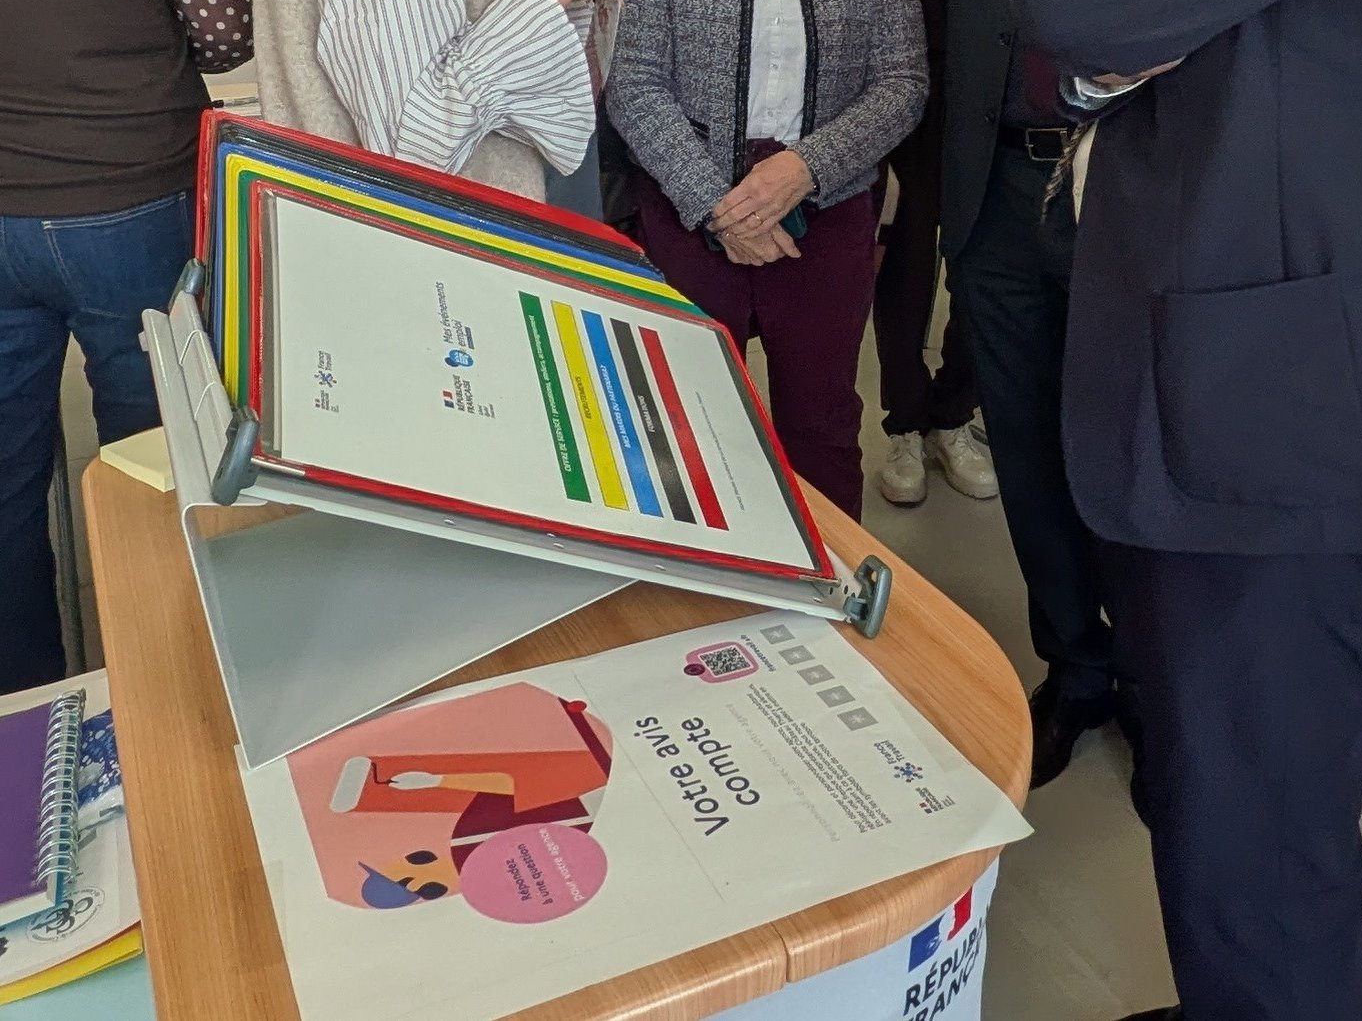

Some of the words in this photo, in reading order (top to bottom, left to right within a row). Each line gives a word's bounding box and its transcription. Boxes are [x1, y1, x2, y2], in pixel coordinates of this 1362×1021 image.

[435, 281, 451, 327] événements
[443, 327, 453, 344] Mes
[452, 318, 466, 347] emploi
[452, 374, 465, 412] RÉPUBLIQUE
[462, 380, 475, 414] FRANÇAISE
[599, 364, 617, 401] PARTENARIAT
[610, 402, 620, 410] DU
[638, 395, 656, 433] FORMATIONS
[551, 417, 565, 441] SERVICE
[556, 441, 567, 452] DE
[559, 451, 572, 472] OFFRE
[633, 716, 680, 758] avis
[874, 742, 897, 765] France
[681, 717, 760, 805] compte
[669, 763, 729, 836] Votre
[518, 844, 543, 879] question
[506, 859, 532, 901] Répondez
[536, 880, 550, 897] une
